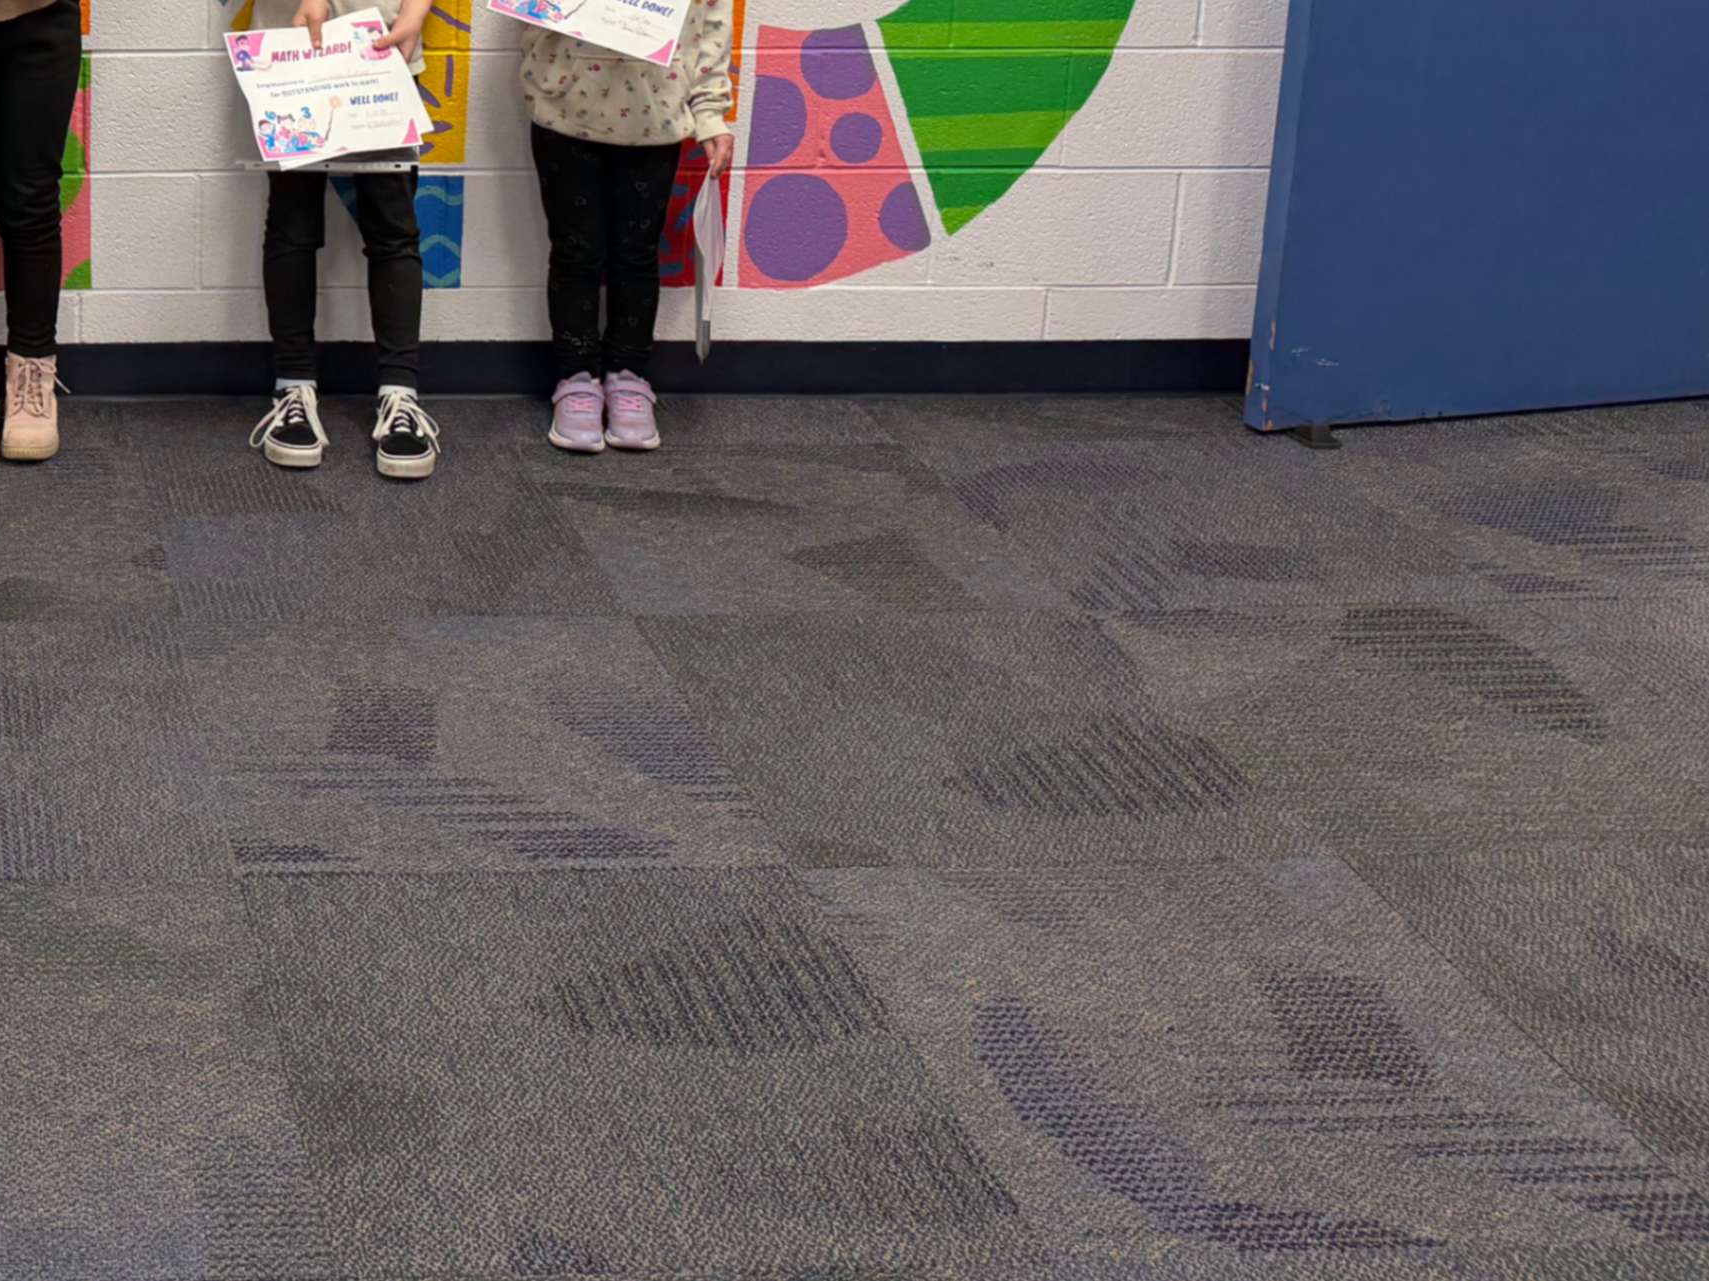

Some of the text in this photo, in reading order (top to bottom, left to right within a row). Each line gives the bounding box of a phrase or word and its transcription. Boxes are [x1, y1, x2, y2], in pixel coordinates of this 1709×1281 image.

[641, 0, 675, 17] DONE!
[271, 42, 352, 62] MATH WIZARD!
[350, 92, 399, 105] WELL DONE!
[301, 107, 311, 119] 3
